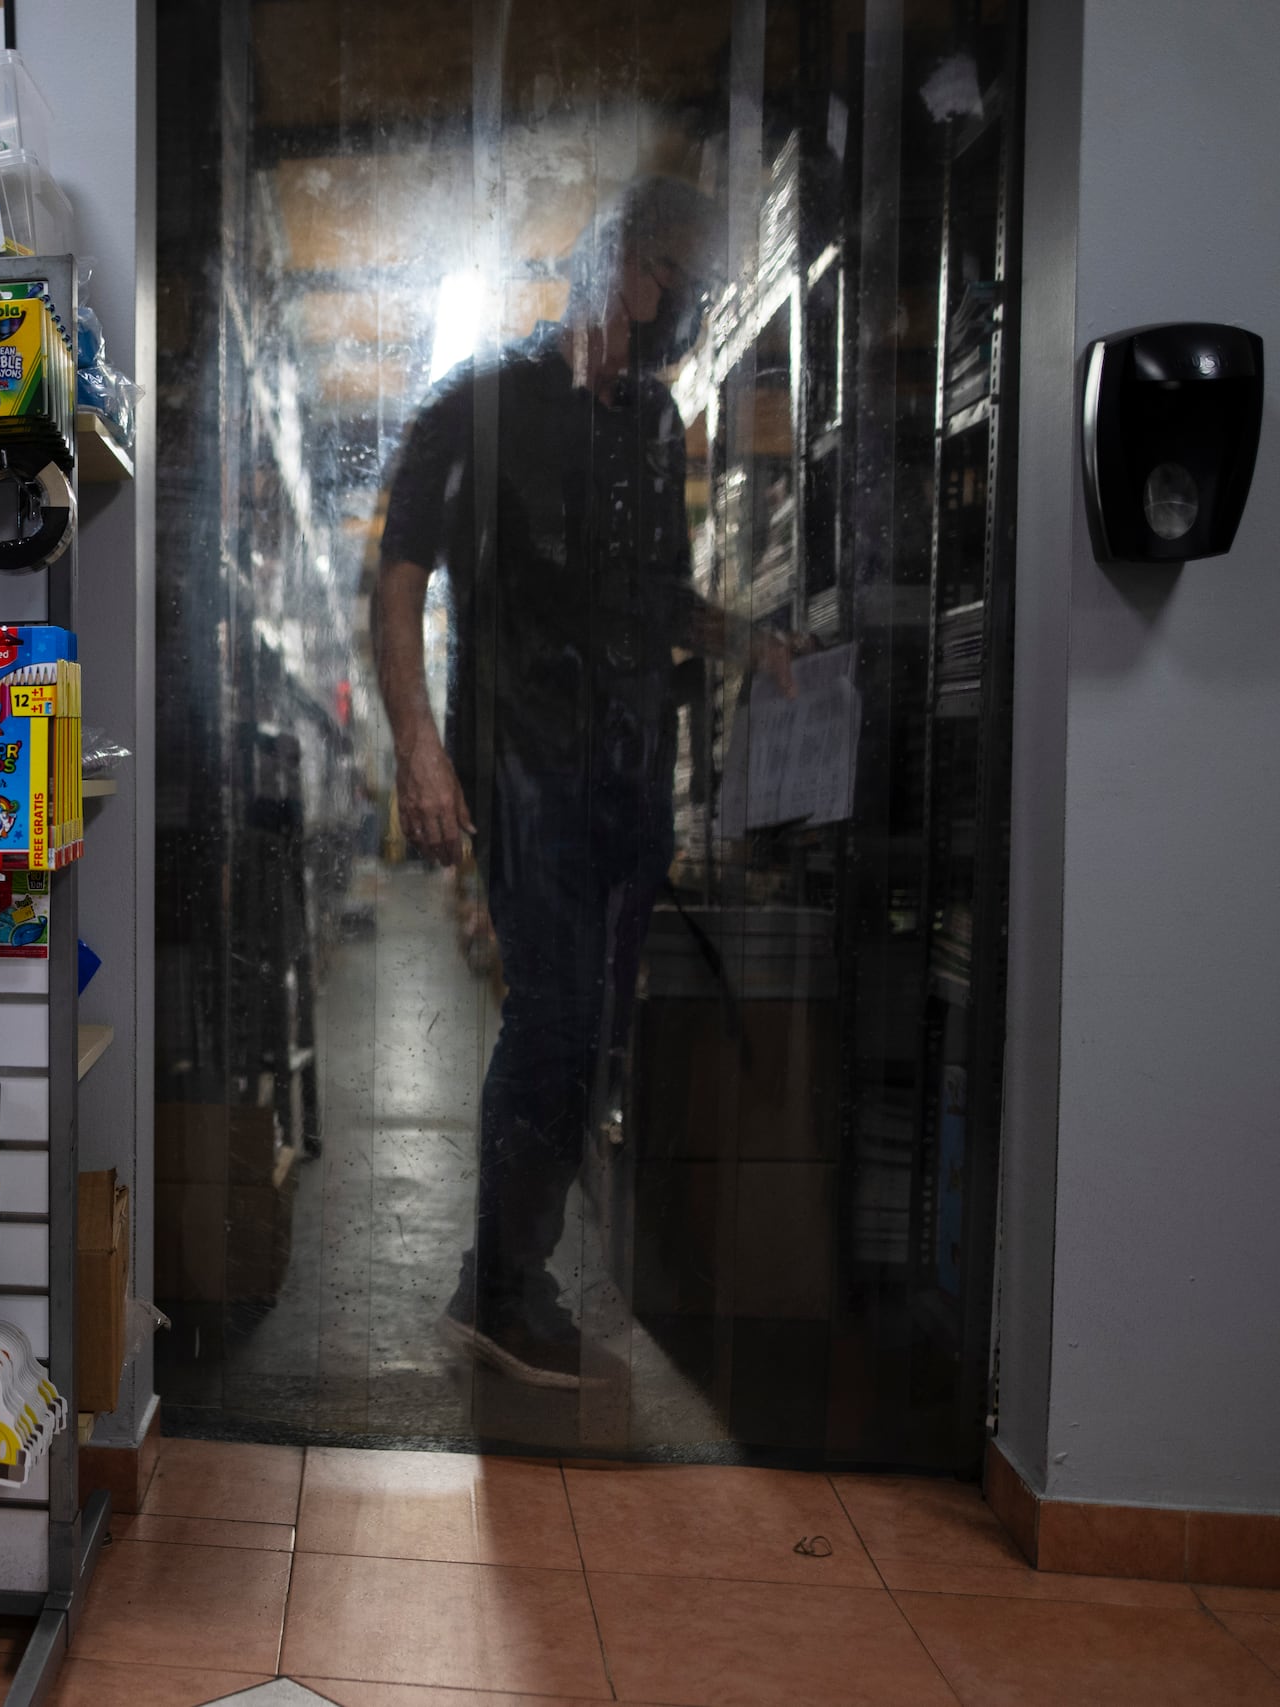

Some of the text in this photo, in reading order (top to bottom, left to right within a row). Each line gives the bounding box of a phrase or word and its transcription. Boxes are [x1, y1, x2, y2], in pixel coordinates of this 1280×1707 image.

[31, 688, 44, 697] +1
[14, 694, 29, 707] 12
[31, 704, 44, 714] +1
[33, 792, 44, 867] FREE GRATIS
